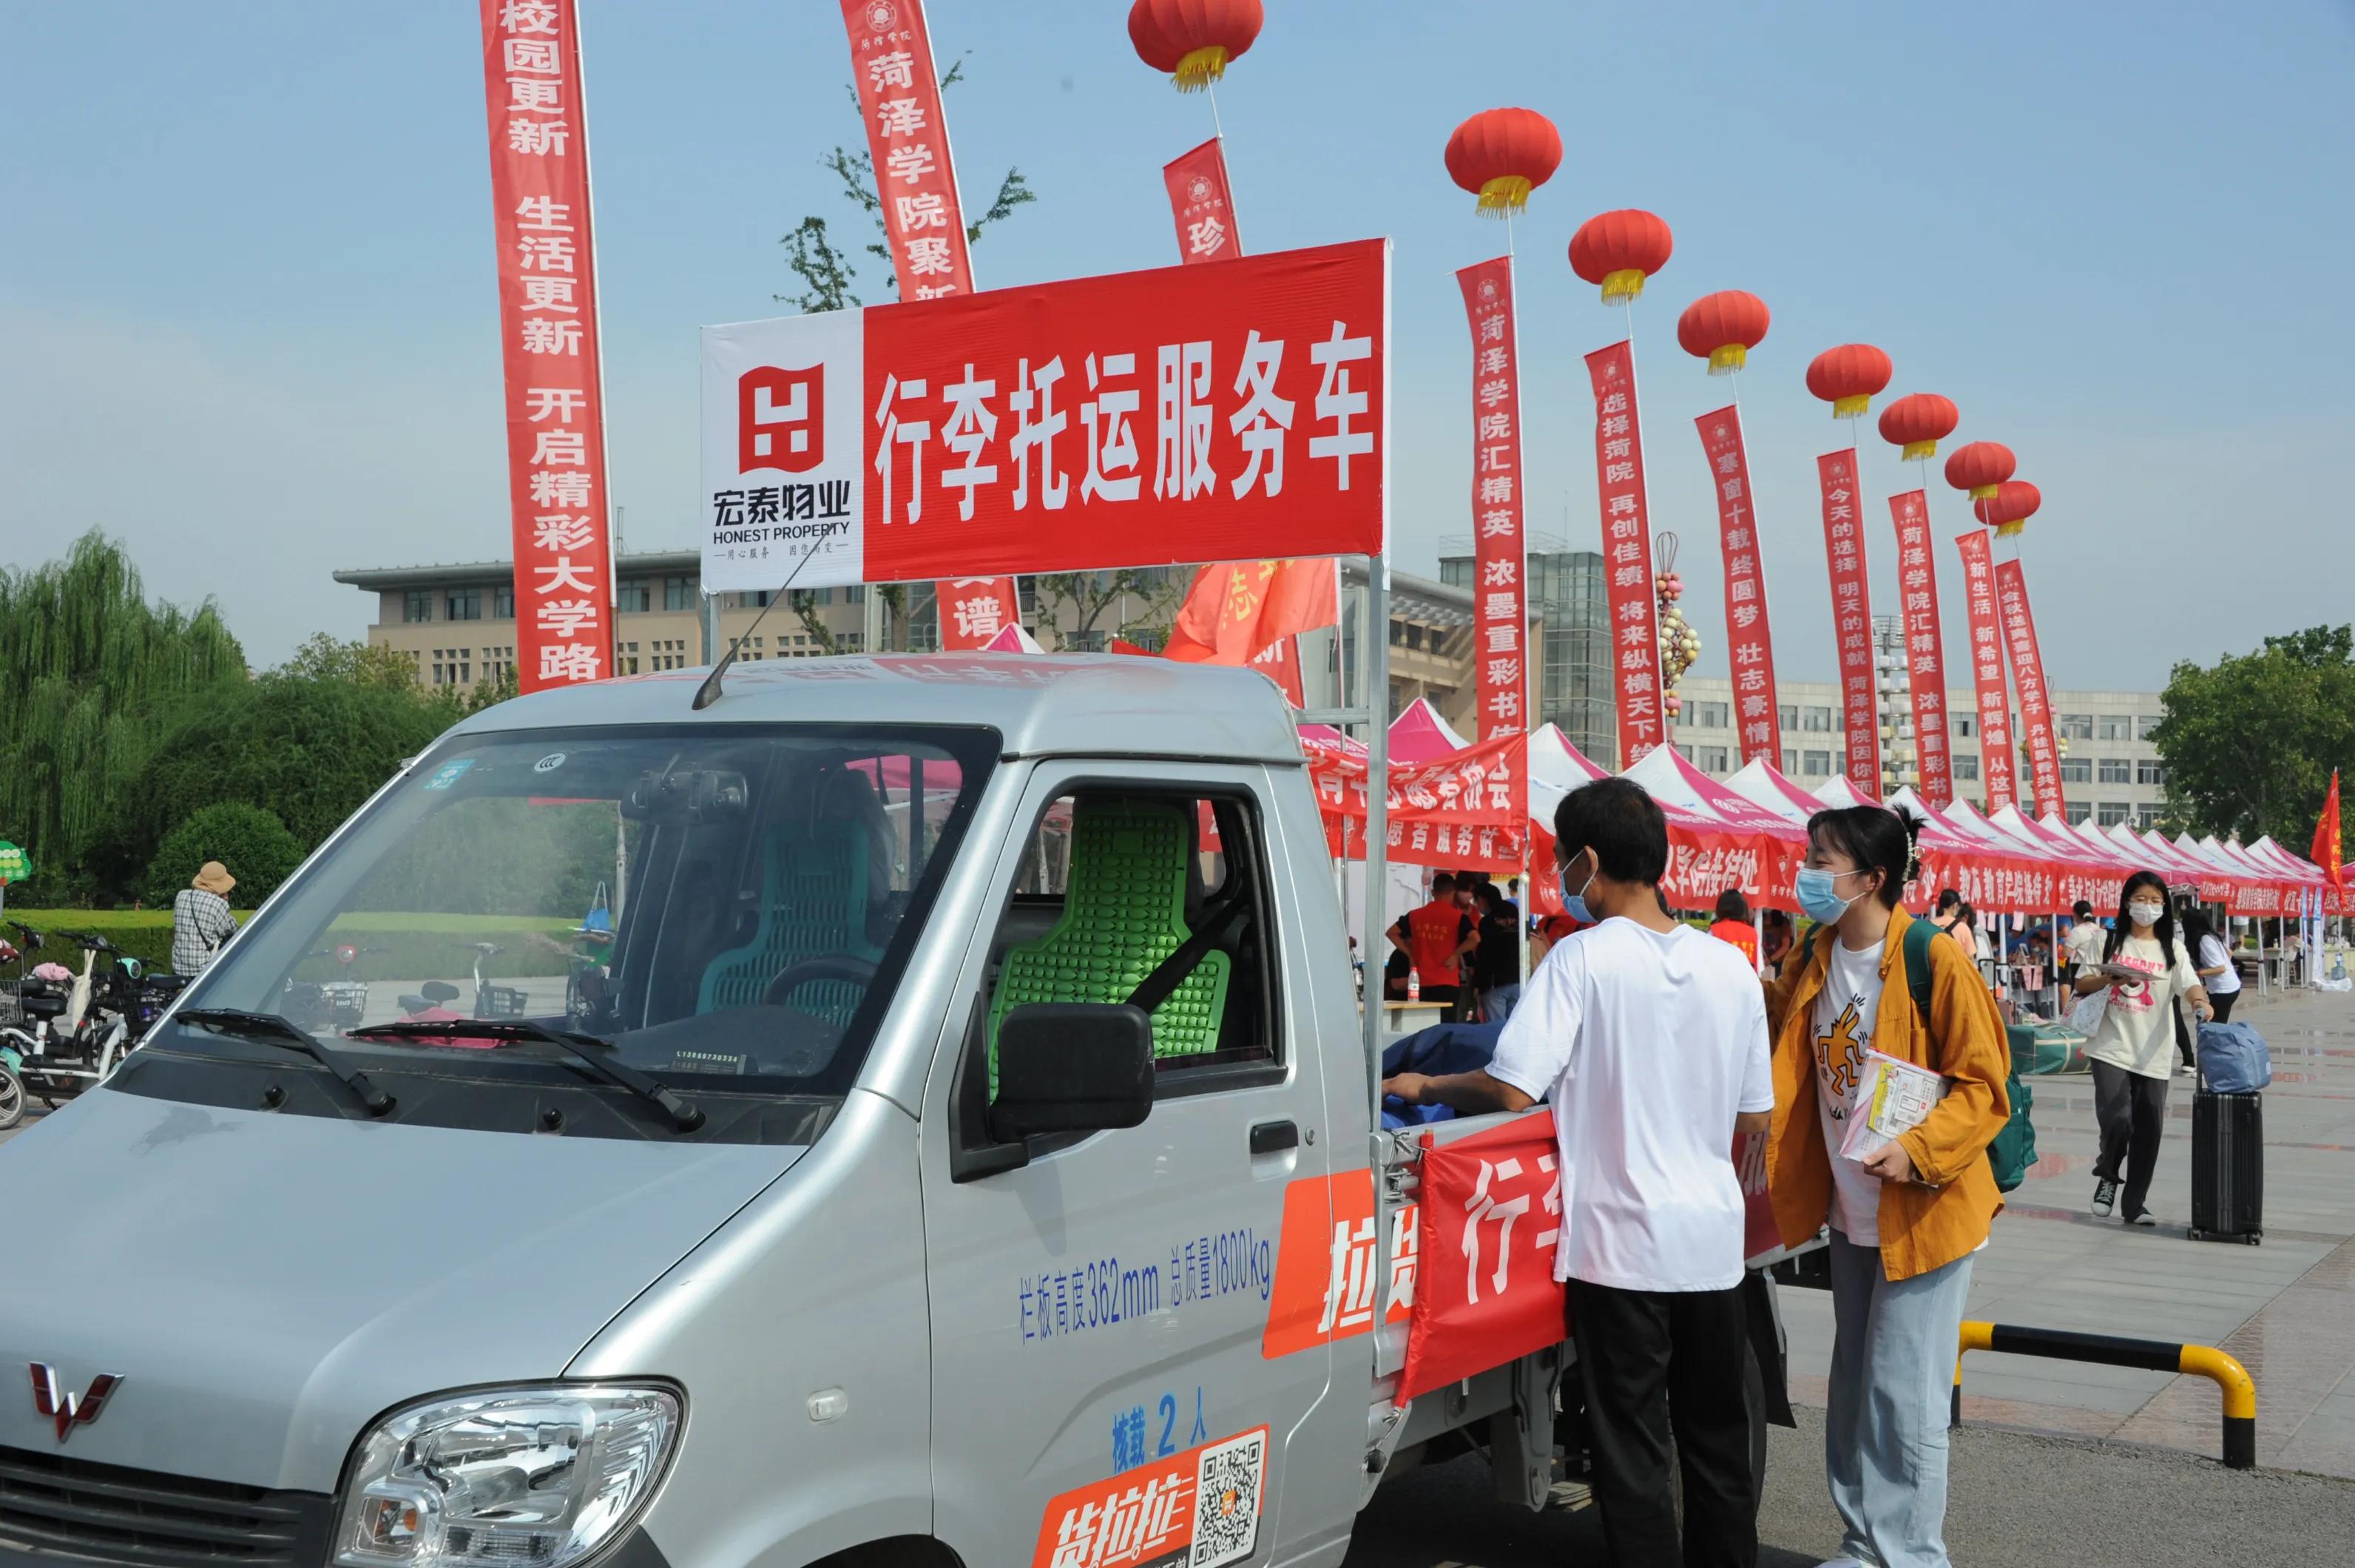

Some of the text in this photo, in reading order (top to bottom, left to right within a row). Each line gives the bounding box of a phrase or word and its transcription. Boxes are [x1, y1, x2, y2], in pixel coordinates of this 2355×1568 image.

[1187, 217, 1225, 256] 珍
[499, 0, 601, 680] 校园更新 生活更新 开启精彩大学路
[874, 320, 1374, 525] 行李托运服务车
[1479, 314, 1514, 538] 菏泽学院汇精英
[1602, 393, 1635, 484] 选择菏院
[713, 521, 850, 544] HONEST PROPERTY
[714, 480, 851, 527] 宏泰物业
[1608, 493, 1644, 587] 再创佳绩
[1828, 488, 1858, 573] 今天的选择
[1837, 581, 1866, 666] 明天的成就
[1902, 526, 1937, 675] 菏泽学院汇精英
[1970, 561, 1991, 615] 新生活
[1976, 626, 1999, 681] 新希望
[1019, 1228, 1271, 1346] 栏板高度362mm 总质量1800kg
[1112, 1386, 1207, 1474] 核载 2 人
[1050, 1472, 1186, 1568] 货拉拉
